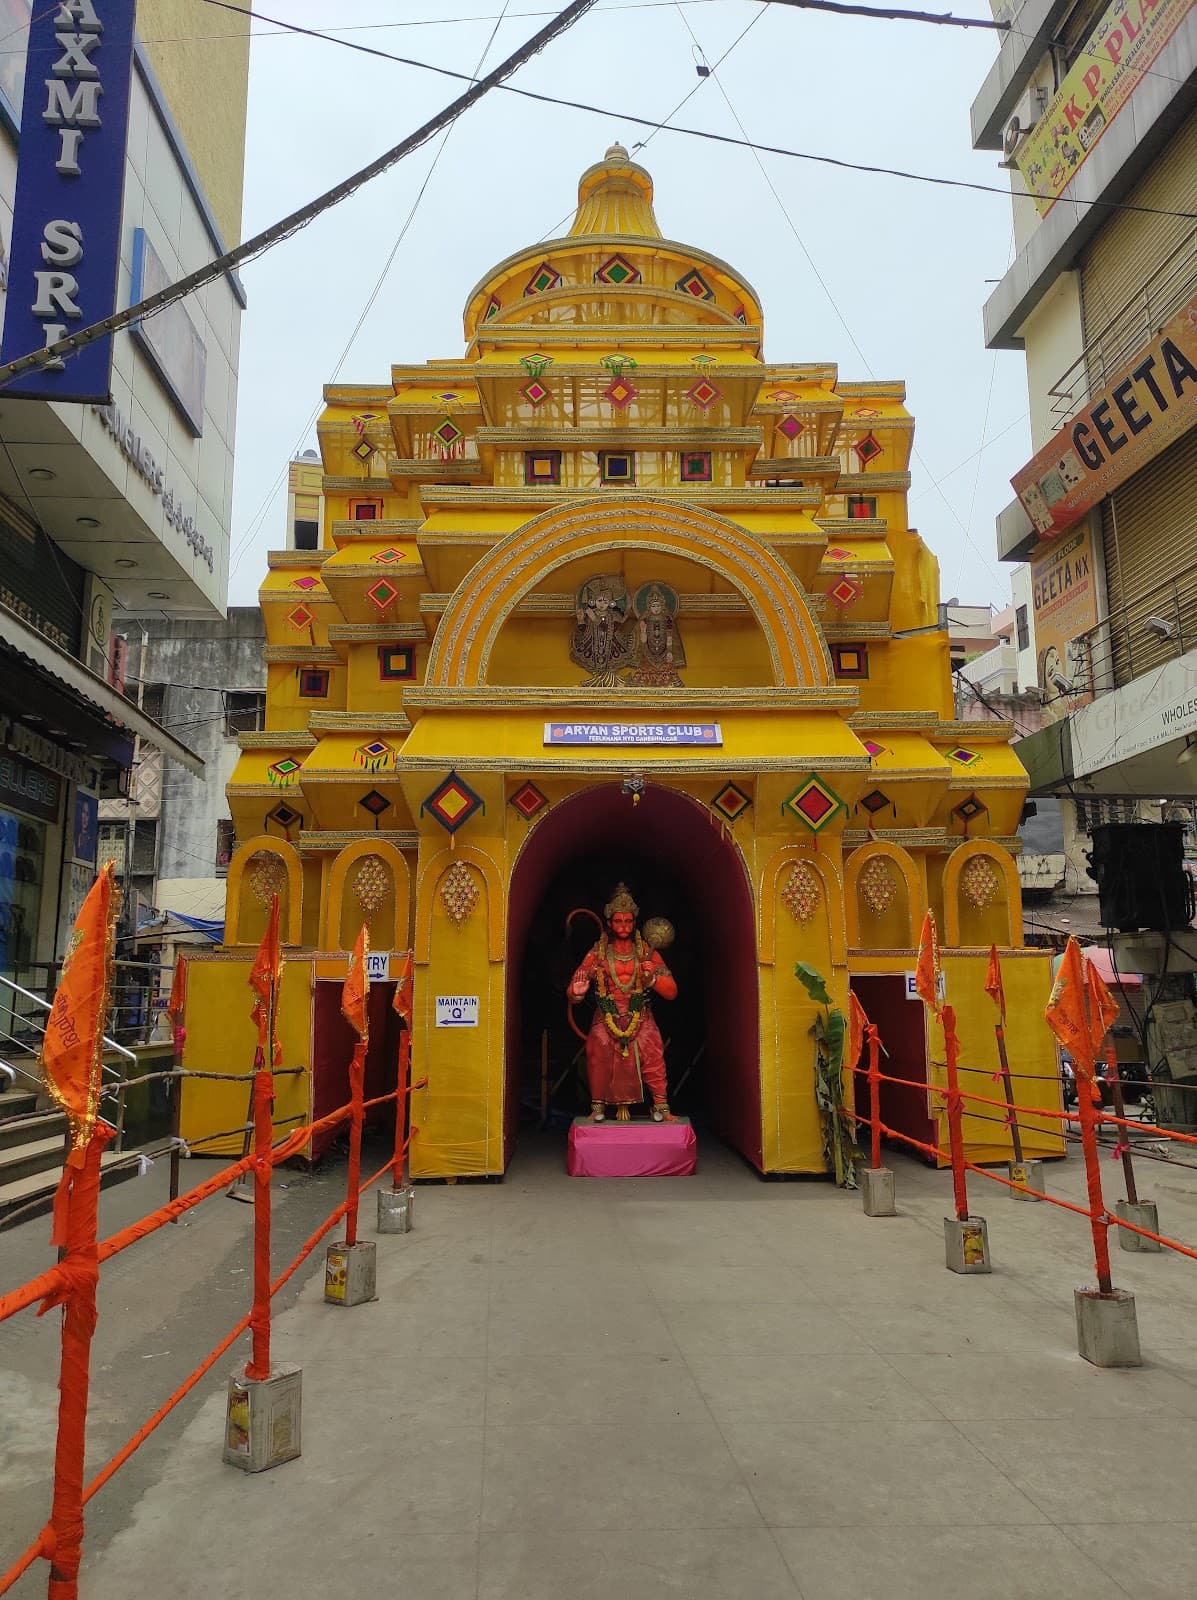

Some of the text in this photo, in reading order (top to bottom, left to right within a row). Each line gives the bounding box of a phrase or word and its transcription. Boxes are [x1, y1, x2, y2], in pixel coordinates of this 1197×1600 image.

[1125, 34, 1146, 67] DEALERS
[32, 219, 84, 370] SRI
[1071, 337, 1197, 471] GEETA
[1034, 560, 1072, 610] GEETA
[1075, 553, 1089, 580] NX
[564, 725, 703, 736] ARYAN SPORTS CLUB
[438, 998, 477, 1006] MAINTAIN
